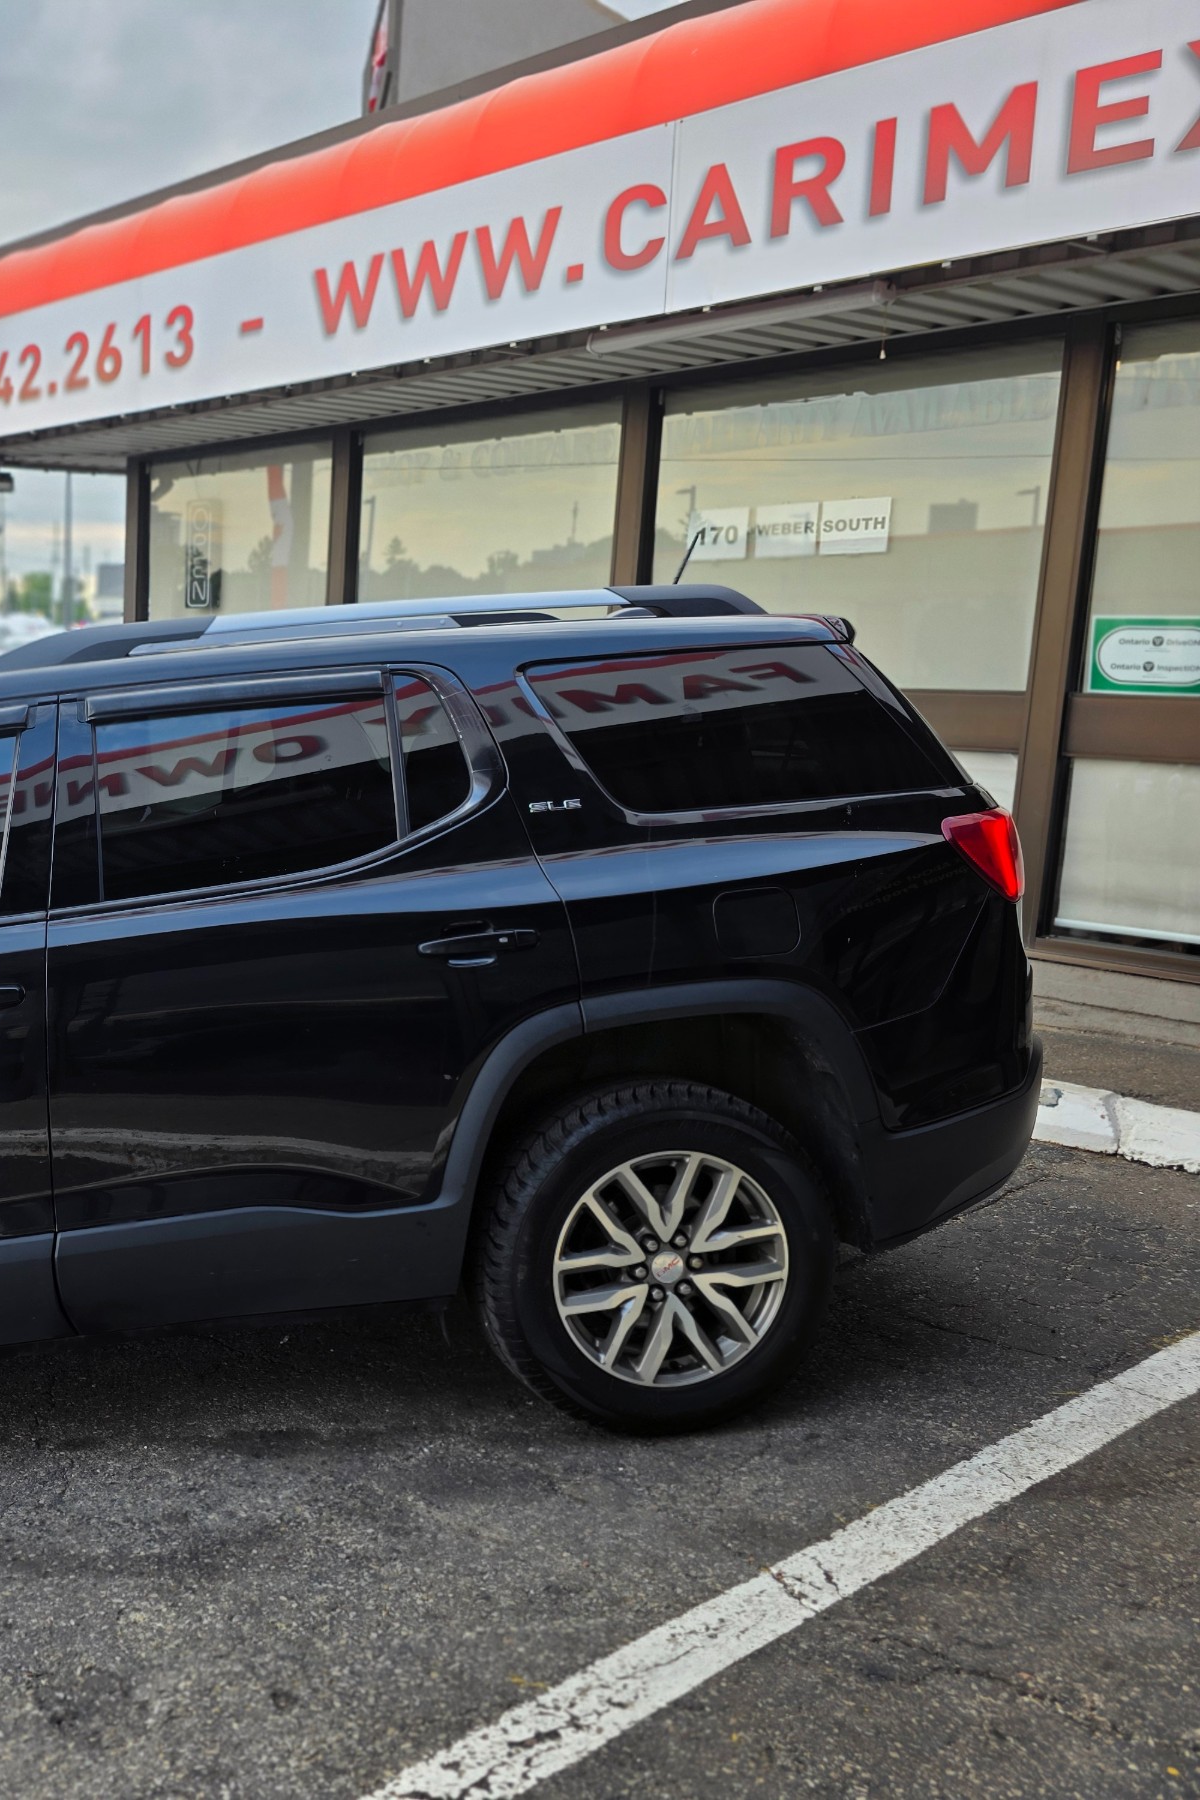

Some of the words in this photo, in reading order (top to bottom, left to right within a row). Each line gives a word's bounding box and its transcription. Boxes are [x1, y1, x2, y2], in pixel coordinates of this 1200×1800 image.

[699, 525, 738, 546] 170
[756, 521, 815, 537] WEBER
[822, 516, 886, 533] SOUTH
[1119, 637, 1150, 646] Ontario
[1111, 663, 1141, 671] Ontario
[529, 799, 581, 812] SLE
[656, 1255, 680, 1278] GMC
